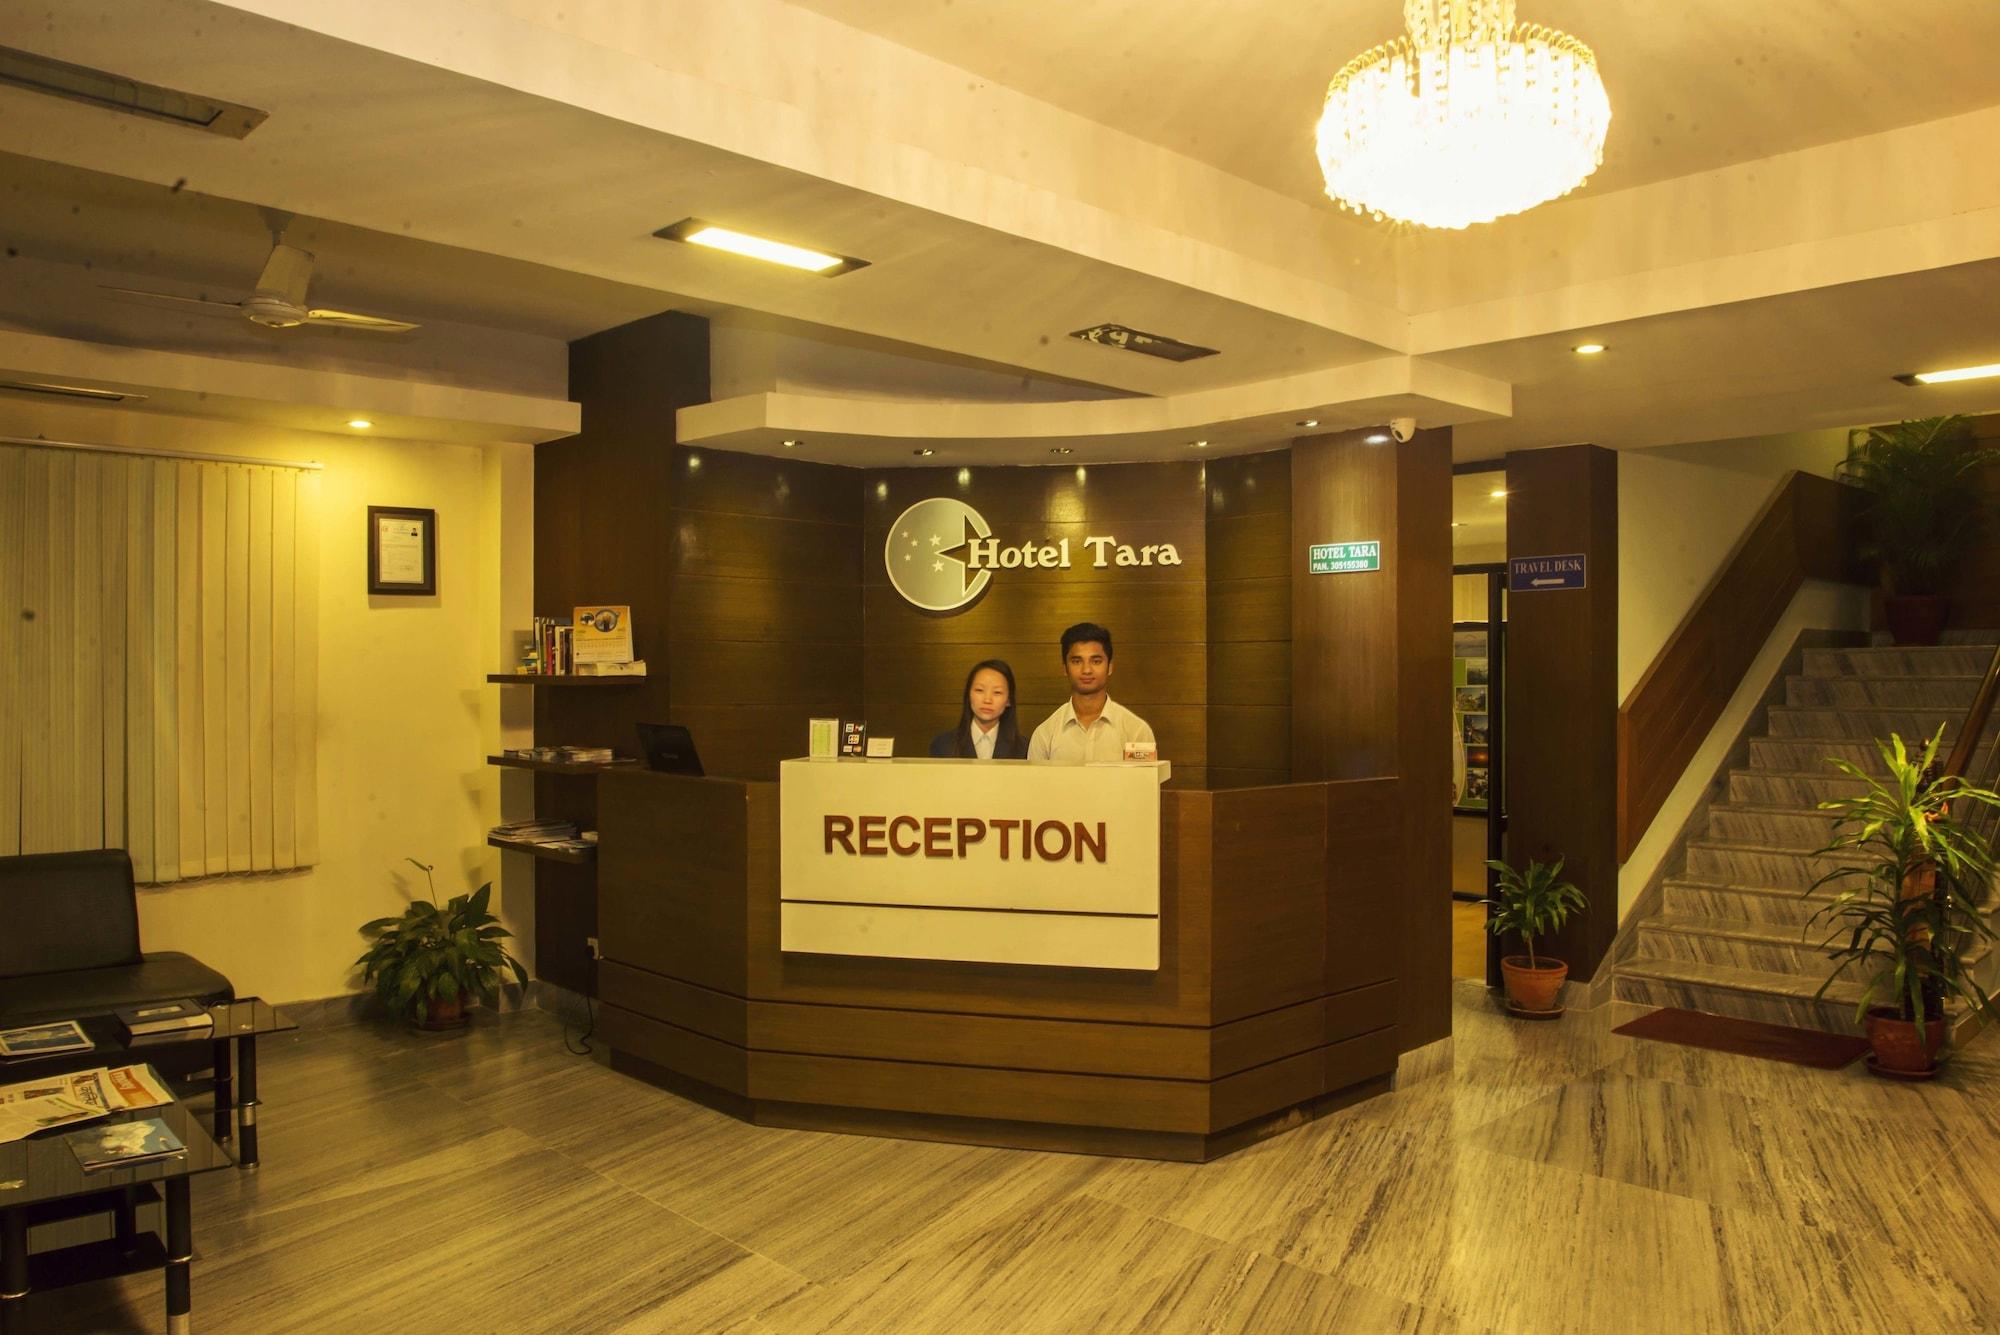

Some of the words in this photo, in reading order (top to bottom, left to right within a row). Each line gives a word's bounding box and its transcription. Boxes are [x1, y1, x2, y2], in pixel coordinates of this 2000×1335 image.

[967, 538, 1072, 569] Hotel
[1083, 536, 1183, 568] Tara
[1313, 547, 1347, 560] HOTEL
[1348, 545, 1377, 558] TARA
[1514, 560, 1552, 574] TRAVEL
[1554, 559, 1583, 572] DESK
[823, 815, 1107, 863] RECEPTION
